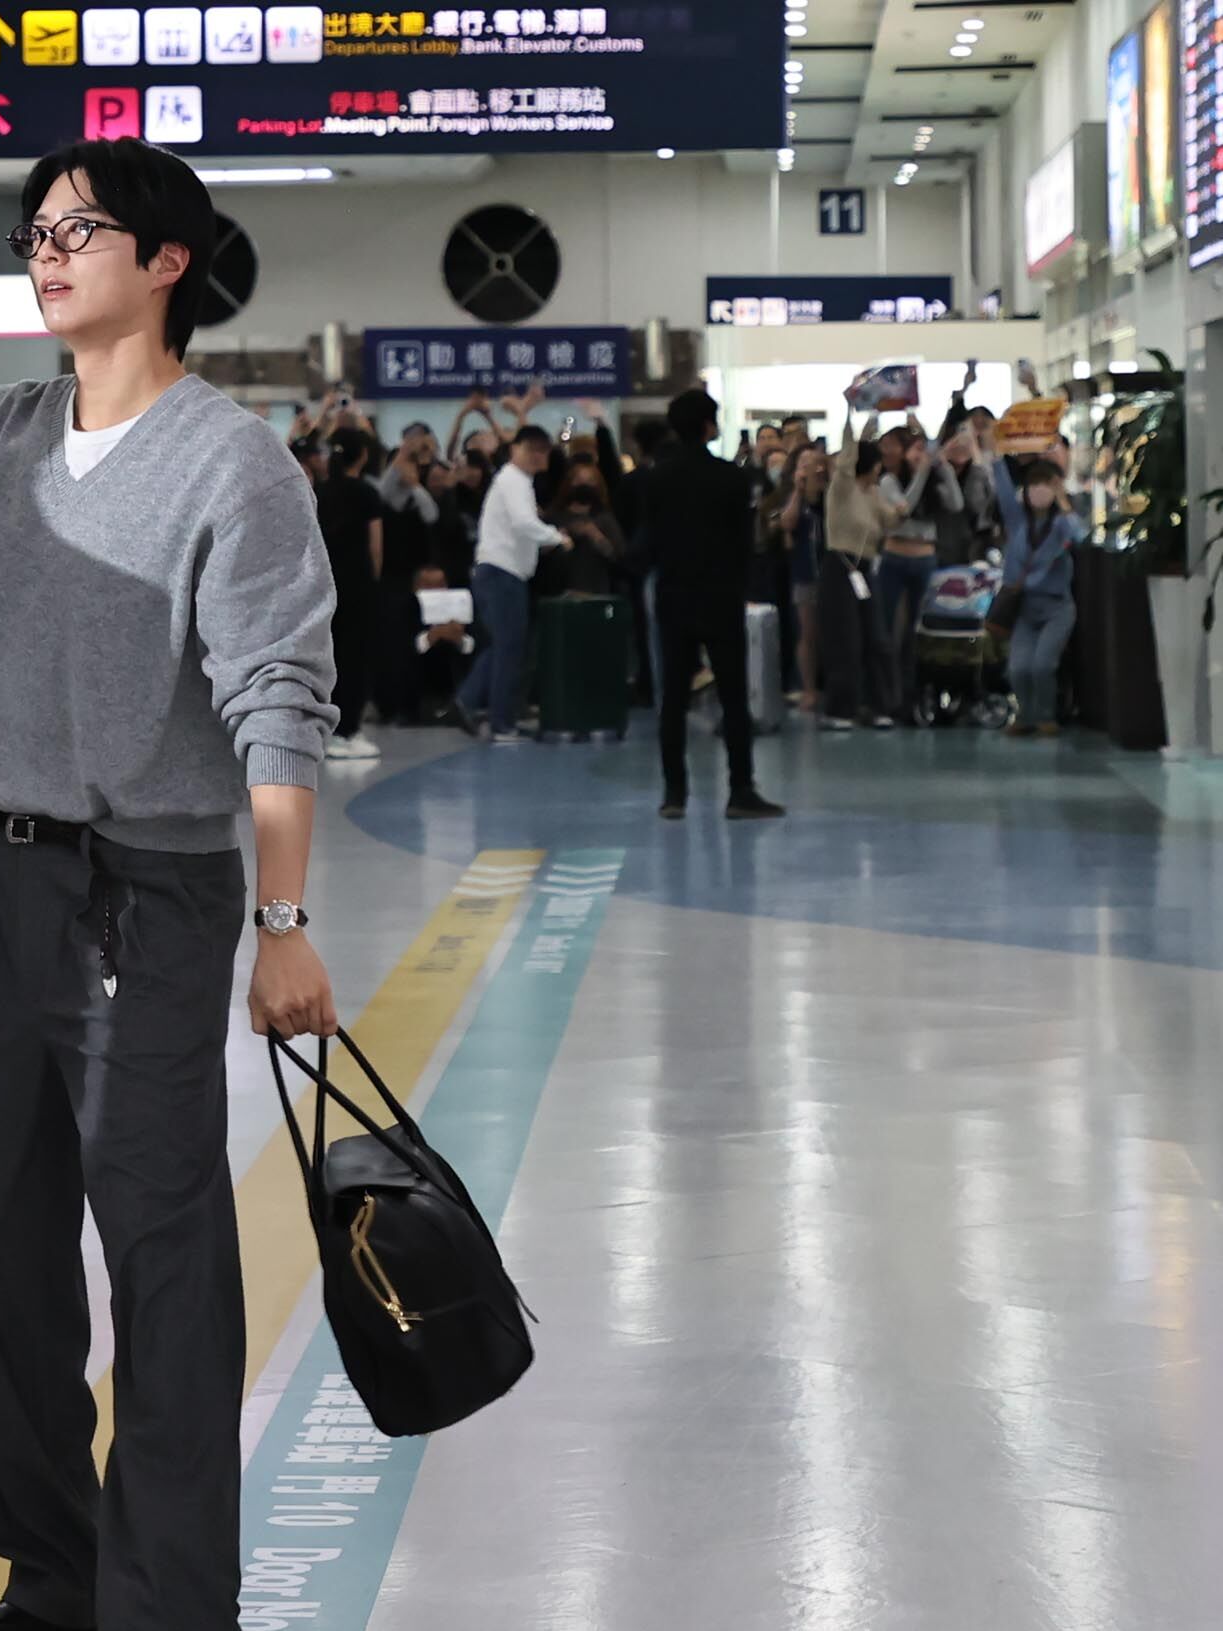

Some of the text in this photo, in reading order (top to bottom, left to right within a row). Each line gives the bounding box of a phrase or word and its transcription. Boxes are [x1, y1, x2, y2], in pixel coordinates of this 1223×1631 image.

[98, 96, 124, 132] P
[490, 115, 554, 131] Workers
[554, 114, 614, 131] Service
[822, 193, 861, 232] 11
[240, 1547, 343, 1597] Door
